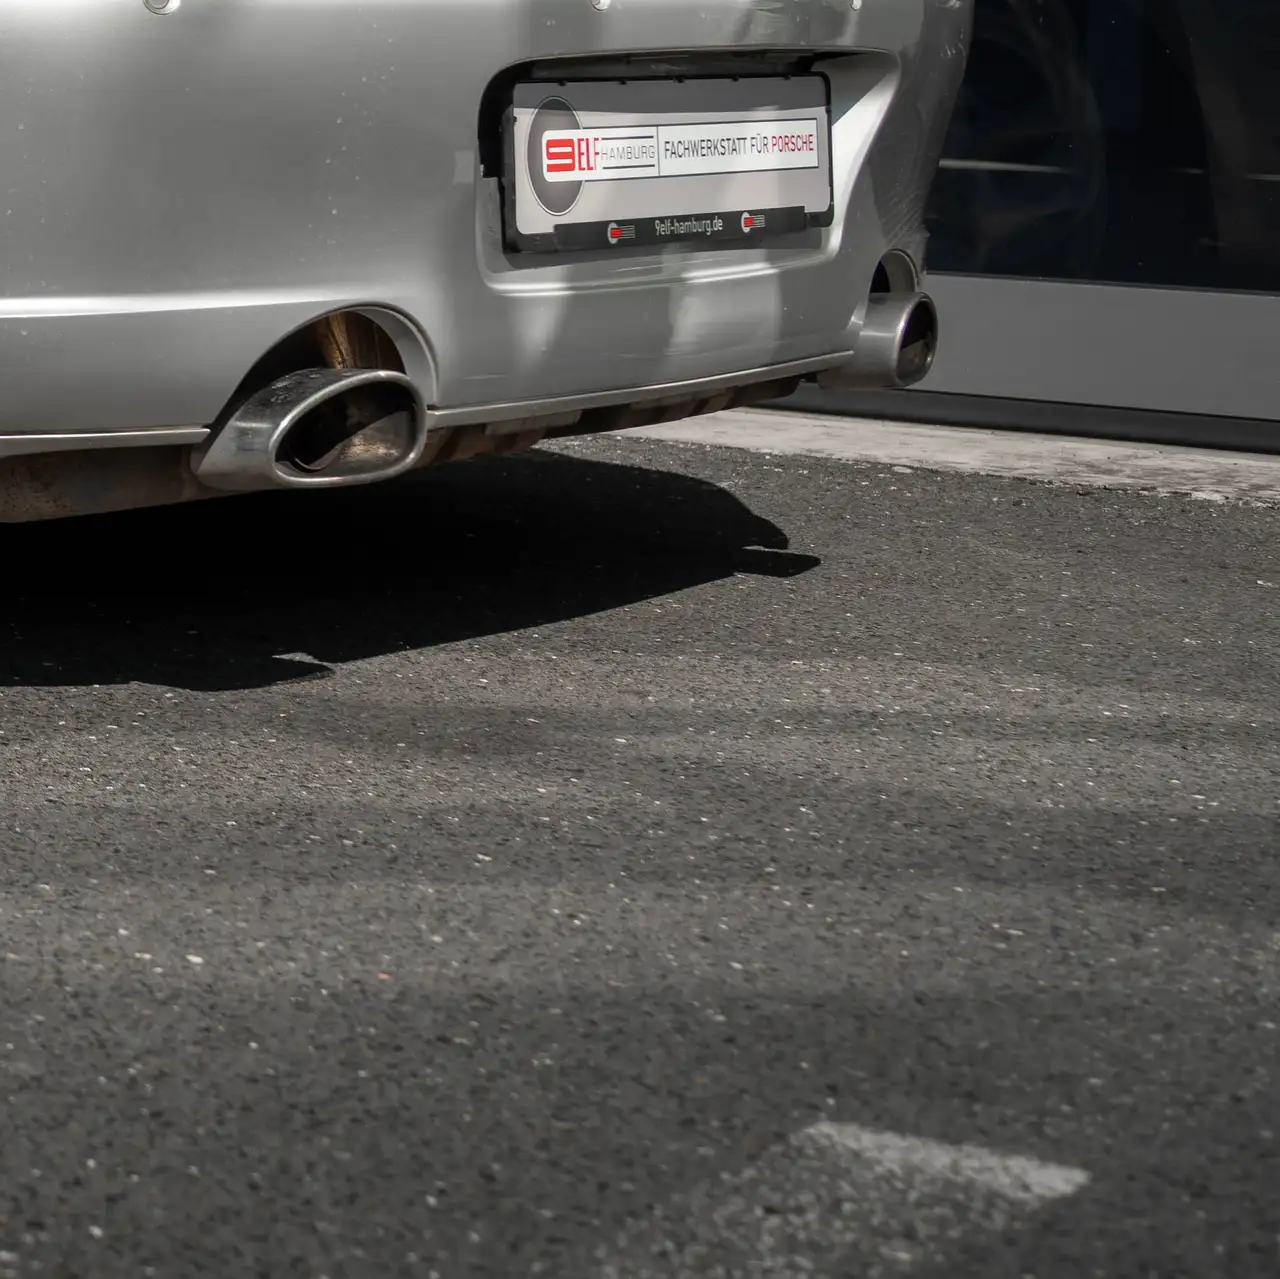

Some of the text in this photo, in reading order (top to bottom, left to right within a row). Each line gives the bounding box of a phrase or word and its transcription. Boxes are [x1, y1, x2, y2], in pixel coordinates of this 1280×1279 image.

[546, 136, 656, 173] 9ELF HAMBURG
[664, 132, 814, 160] FACHWERKSTATT FÜR PORSCHE
[655, 215, 723, 236] 9elf-hamburg.de
